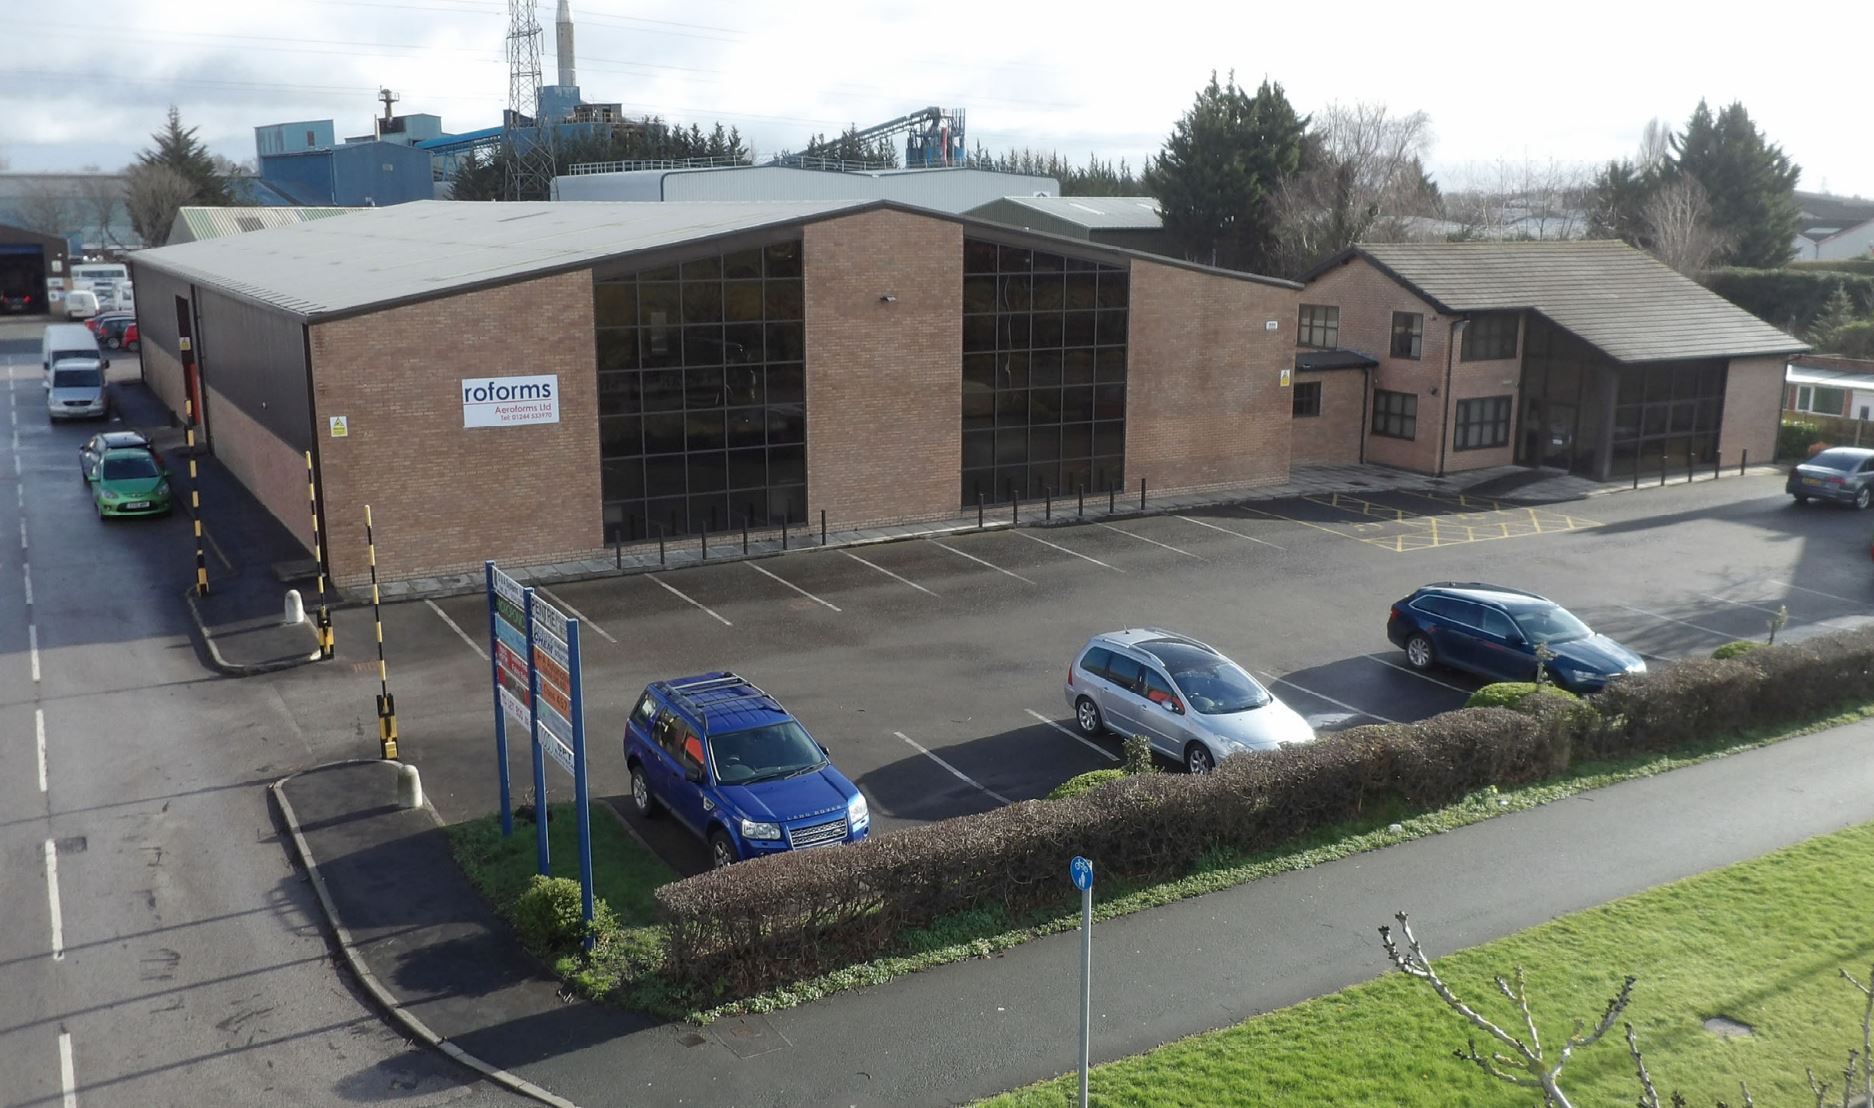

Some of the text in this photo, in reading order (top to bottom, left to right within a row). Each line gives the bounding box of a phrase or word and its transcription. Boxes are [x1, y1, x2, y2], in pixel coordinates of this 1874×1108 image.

[465, 382, 551, 402] roforms
[495, 403, 552, 414] Aeroforms Ltd
